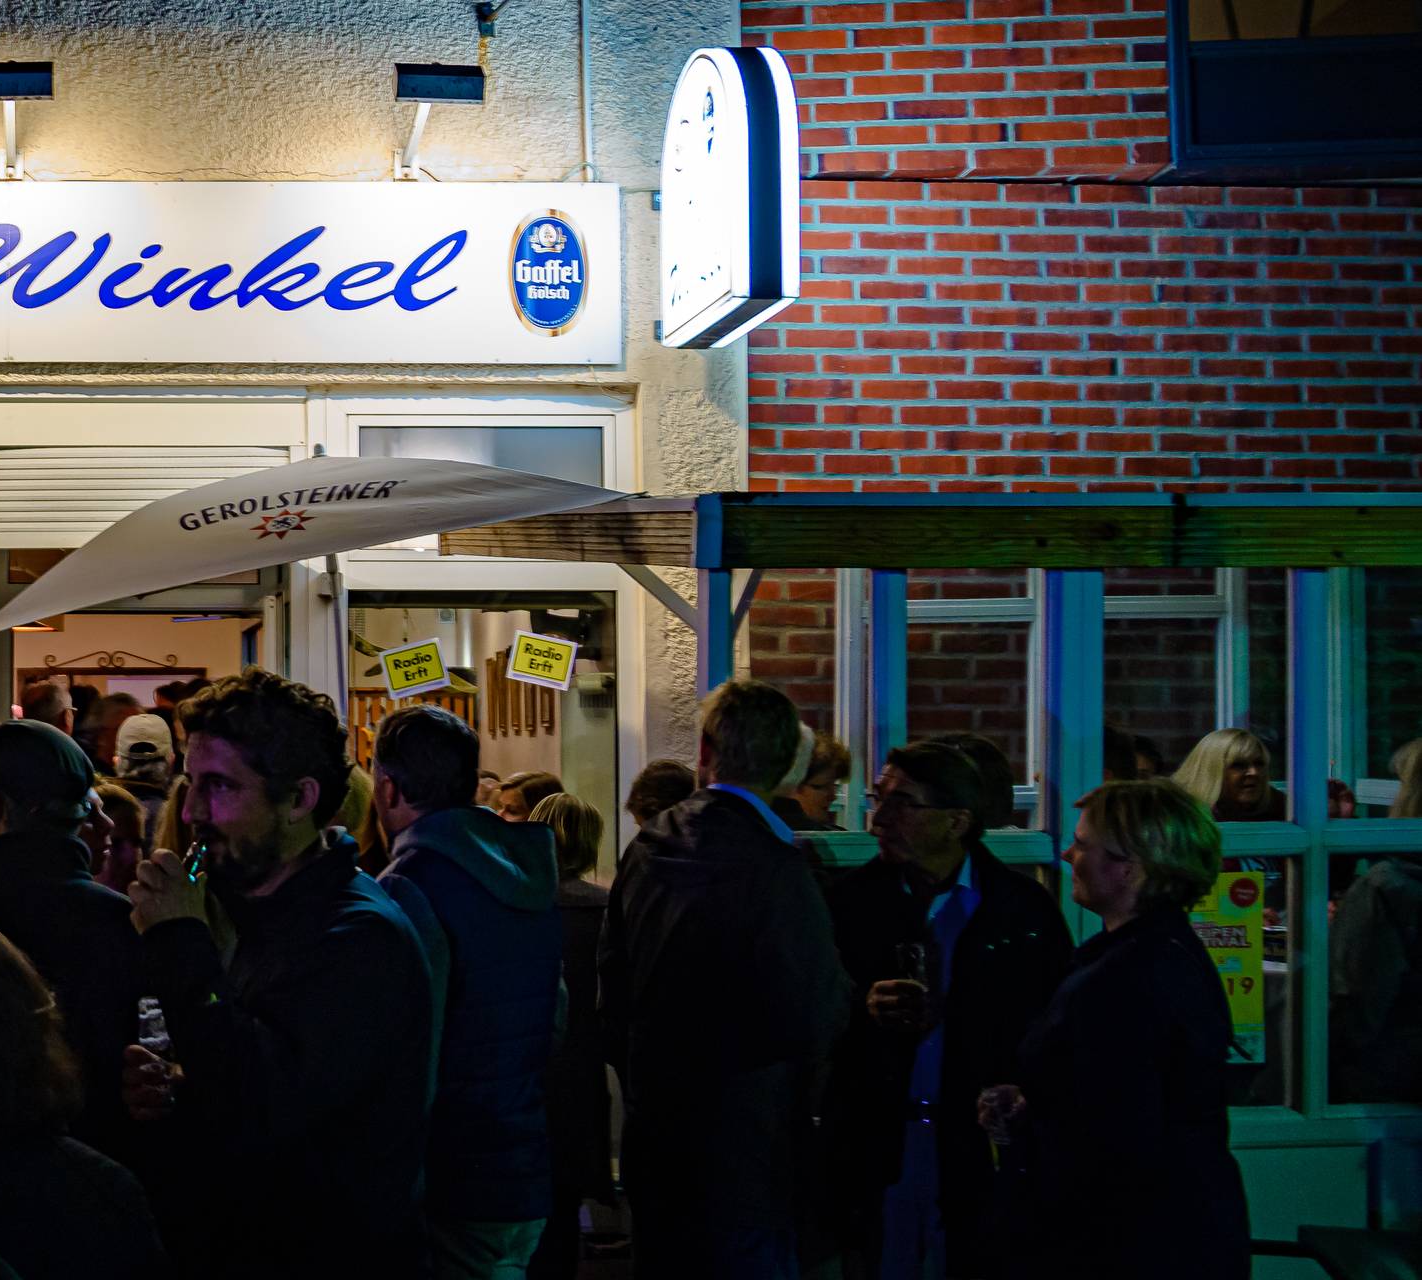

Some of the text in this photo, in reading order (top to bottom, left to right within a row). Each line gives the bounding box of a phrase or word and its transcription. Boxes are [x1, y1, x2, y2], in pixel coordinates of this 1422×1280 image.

[515, 259, 582, 285] Gaffel
[527, 285, 570, 300] Kölsch
[179, 479, 401, 532] GEROLSTEINER
[393, 652, 432, 670] Radio
[524, 643, 563, 661] Radio
[404, 666, 428, 681] Erft
[529, 658, 554, 673] Erft
